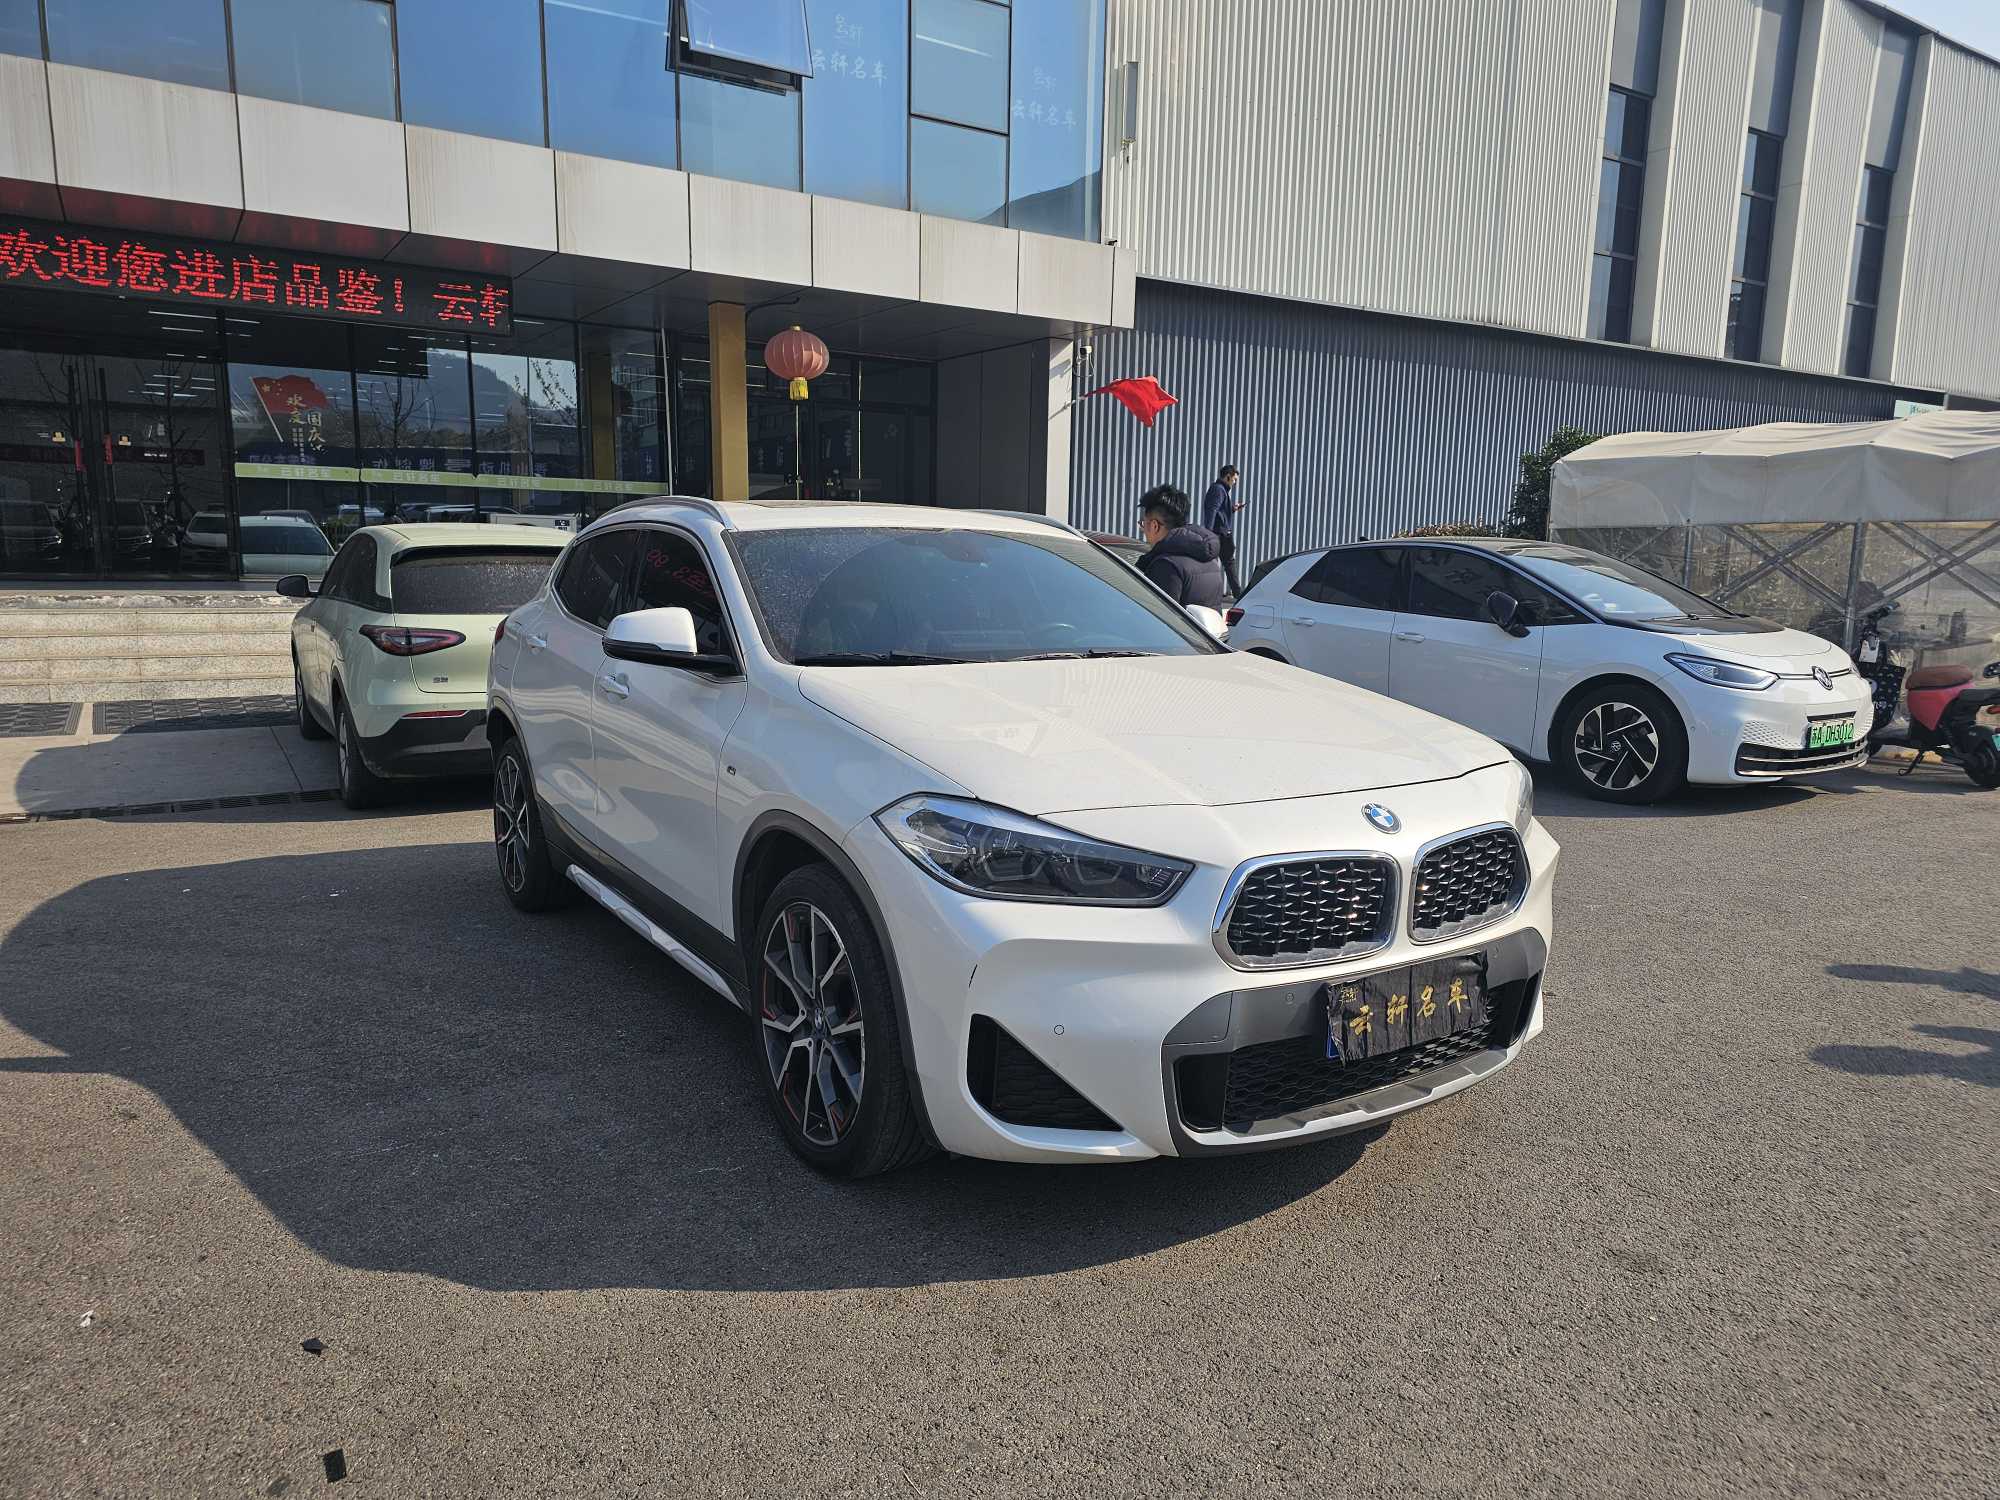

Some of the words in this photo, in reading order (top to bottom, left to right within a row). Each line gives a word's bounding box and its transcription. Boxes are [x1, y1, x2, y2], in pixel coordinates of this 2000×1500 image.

[813, 49, 887, 88] 云轩名车
[1349, 977, 1468, 1036] 云轩名车
